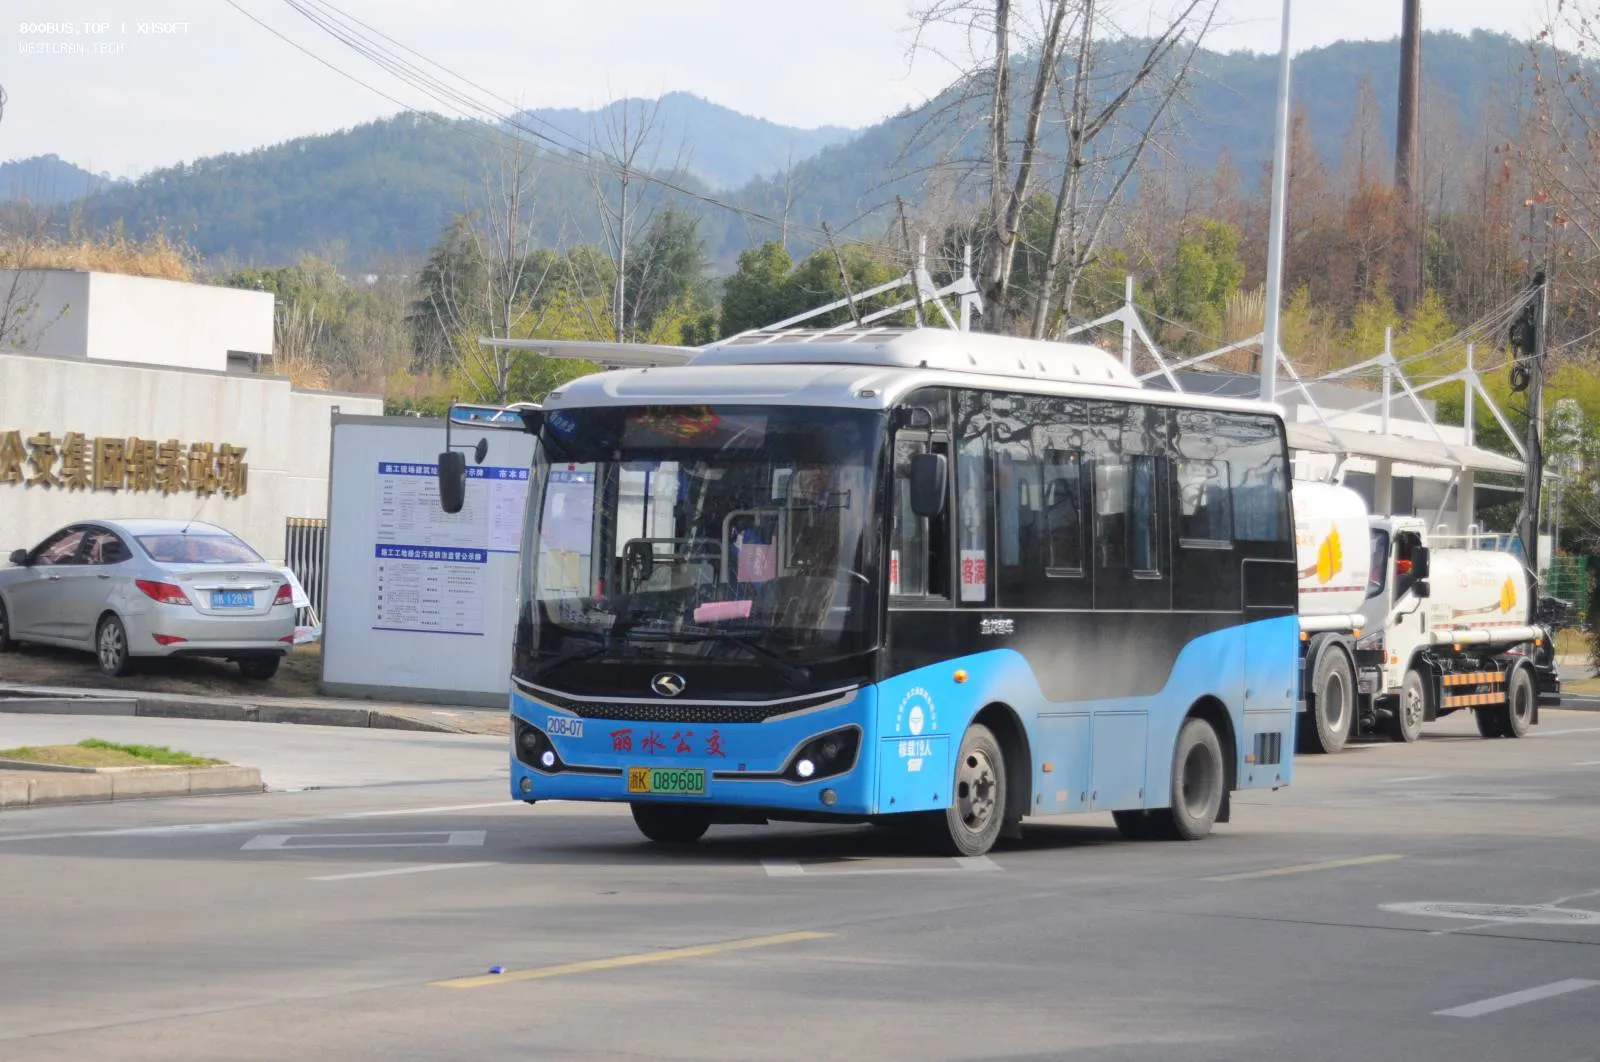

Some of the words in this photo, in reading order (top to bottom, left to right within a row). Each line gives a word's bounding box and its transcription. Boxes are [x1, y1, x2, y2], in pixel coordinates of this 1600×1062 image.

[548, 717, 583, 736] 208-07
[609, 728, 727, 758] 丽水公交
